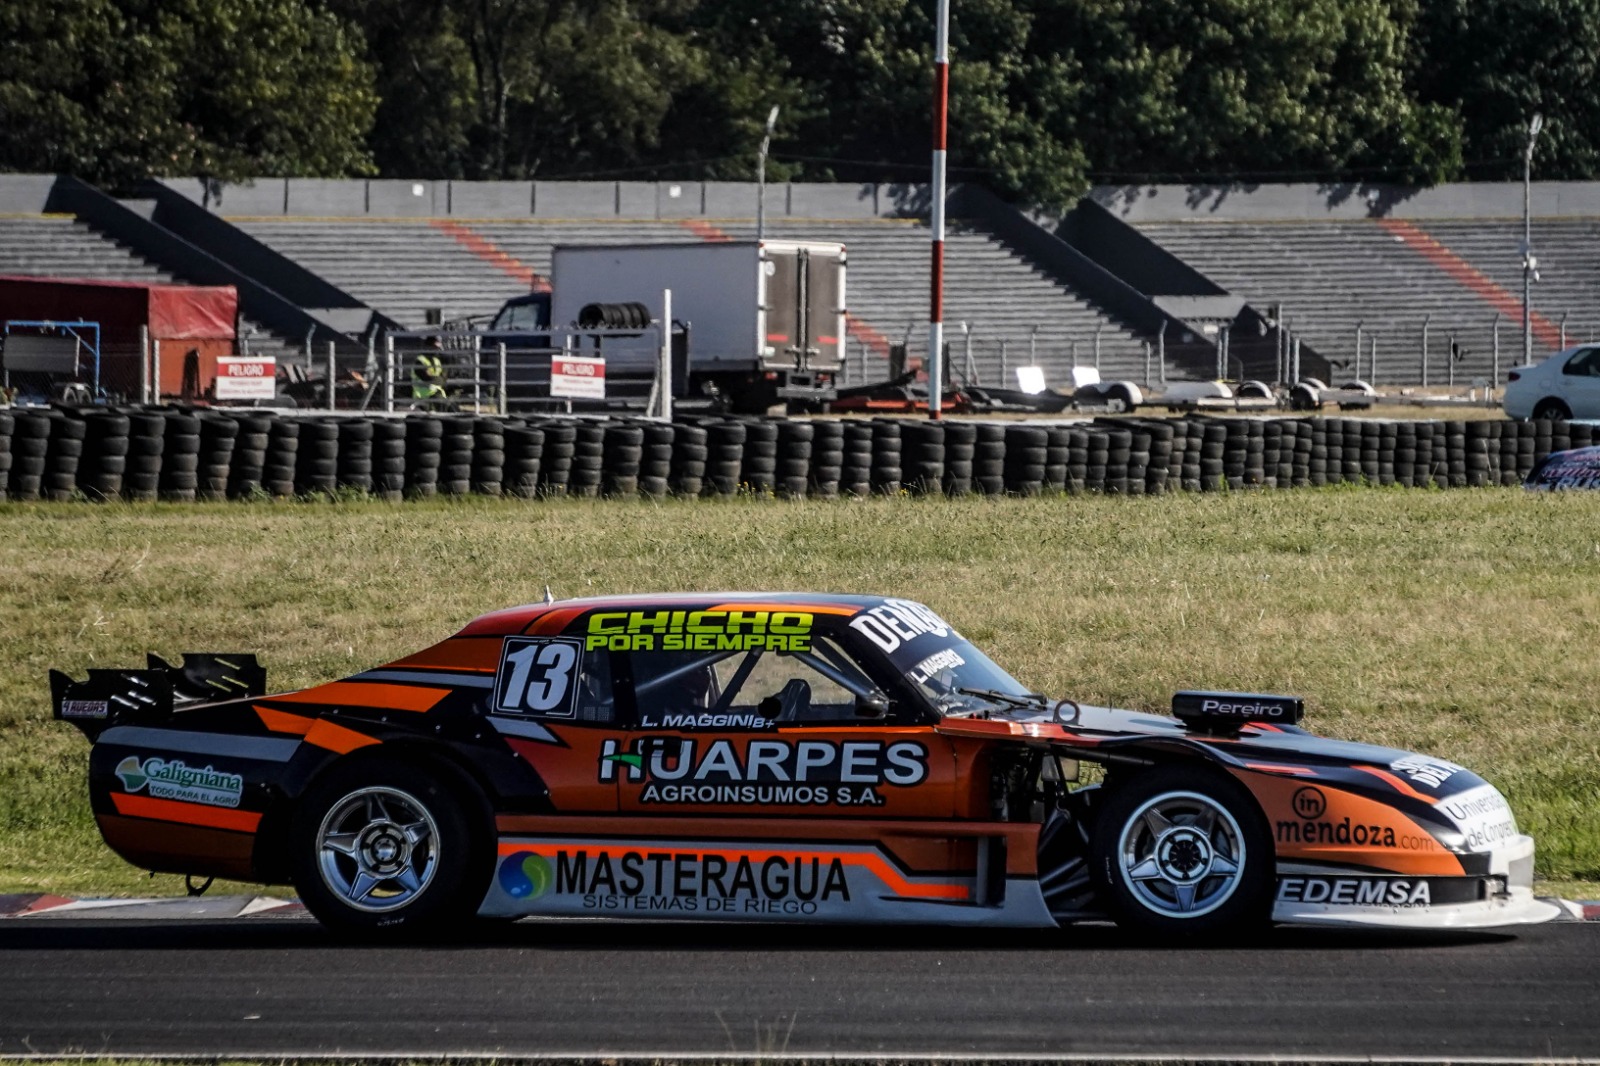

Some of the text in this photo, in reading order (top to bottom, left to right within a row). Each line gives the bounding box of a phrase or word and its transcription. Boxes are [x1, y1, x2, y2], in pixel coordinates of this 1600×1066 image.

[587, 611, 814, 634] CHICHO
[586, 635, 812, 651] POR SIEMPRE
[502, 643, 576, 711] 13
[641, 715, 659, 727] L.
[662, 714, 754, 728] MAGGINI
[601, 740, 925, 783] HUARPES
[143, 759, 241, 790] Galigniana
[151, 785, 174, 796] TODO
[176, 790, 199, 799] PARA
[214, 796, 239, 806] AGRO
[642, 786, 882, 804] AGROINSUMOS S.A.
[556, 850, 850, 902] MASTERAGUA
[1276, 879, 1431, 904] EDEMSA
[582, 894, 818, 915] SISTEMAS DE RIEGO
